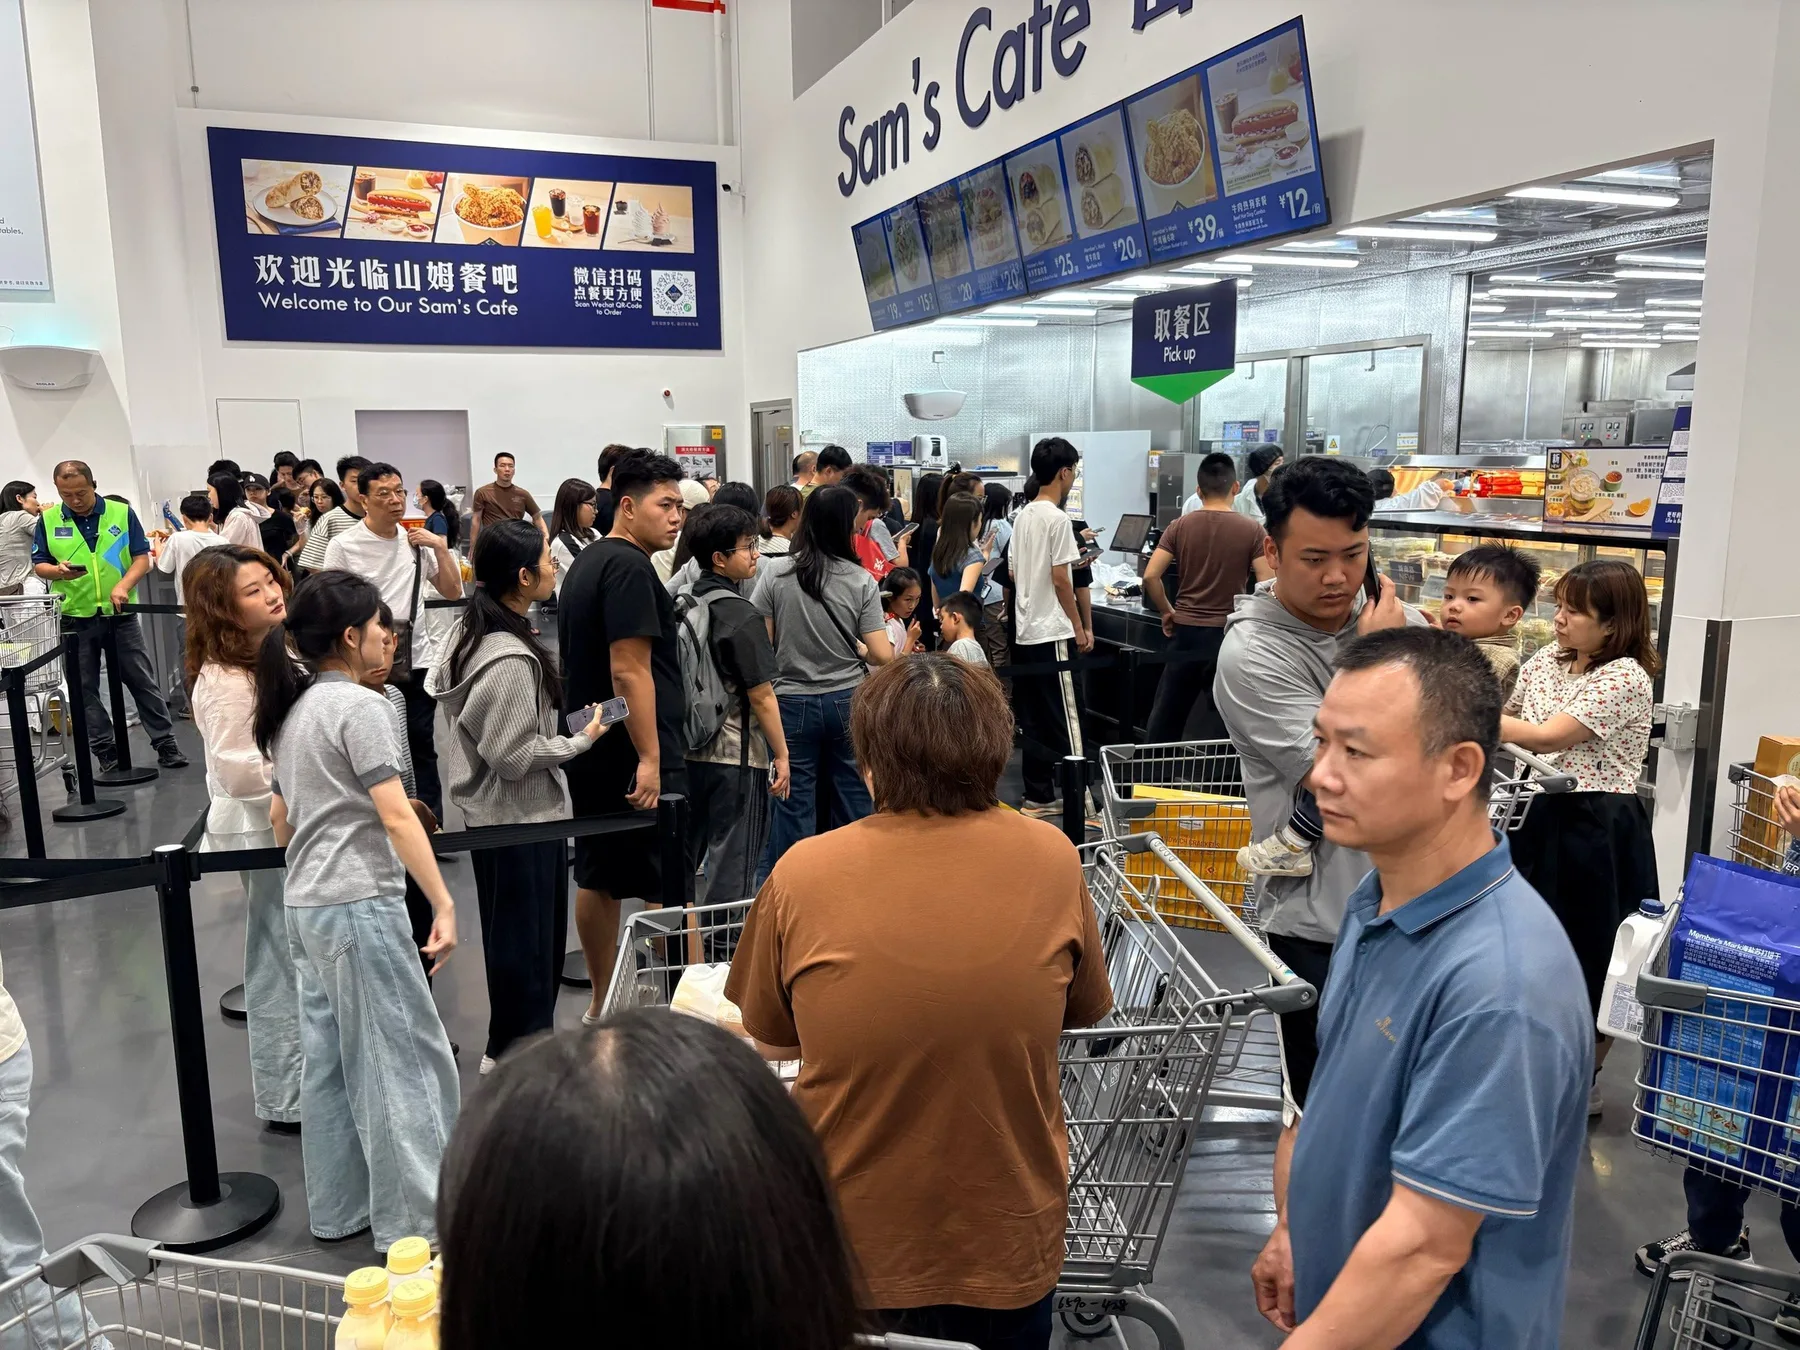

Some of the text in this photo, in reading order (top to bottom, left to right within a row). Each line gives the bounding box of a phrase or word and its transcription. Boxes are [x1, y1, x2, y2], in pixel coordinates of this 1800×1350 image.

[837, 57, 941, 198] Sam's
[253, 254, 519, 295] 欢迎光临山姆餐吧
[573, 266, 642, 287] 微信扫码
[258, 291, 519, 316] Welcome to Our Sam's Cafe
[573, 286, 642, 302] 点餐更方便
[591, 301, 615, 309] Wechat
[615, 302, 642, 310] QR-Code
[1153, 302, 1211, 343] 取餐区
[1163, 345, 1196, 365] Pick up
[1551, 453, 1560, 463] 新
[1688, 928, 1723, 945] Member's
